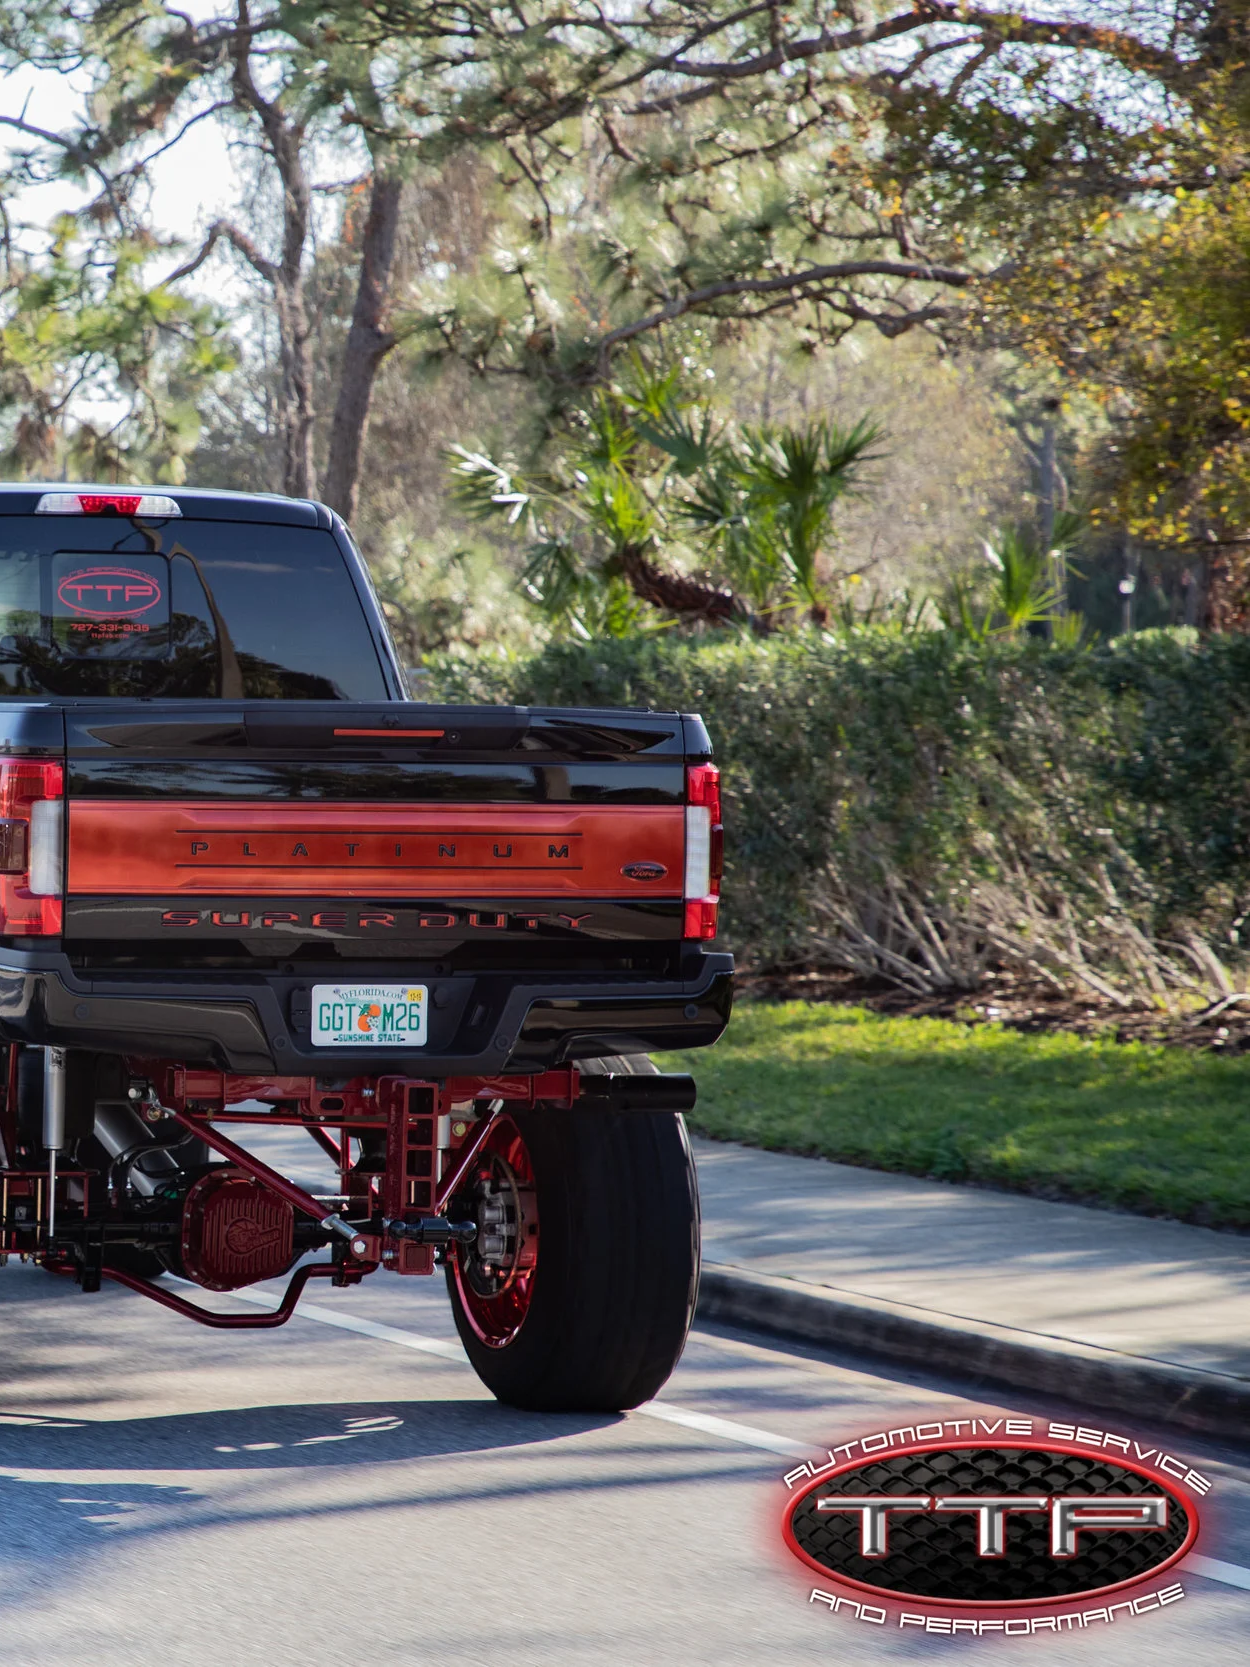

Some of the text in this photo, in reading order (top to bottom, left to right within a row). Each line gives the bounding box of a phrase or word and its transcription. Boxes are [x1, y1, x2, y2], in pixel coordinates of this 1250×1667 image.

[65, 585, 153, 602] TTP
[191, 842, 569, 858] PLATINUM
[161, 911, 593, 929] SUPER DUTY
[319, 1003, 421, 1031] GGT M26
[338, 1033, 401, 1042] SUNSHINE STATE
